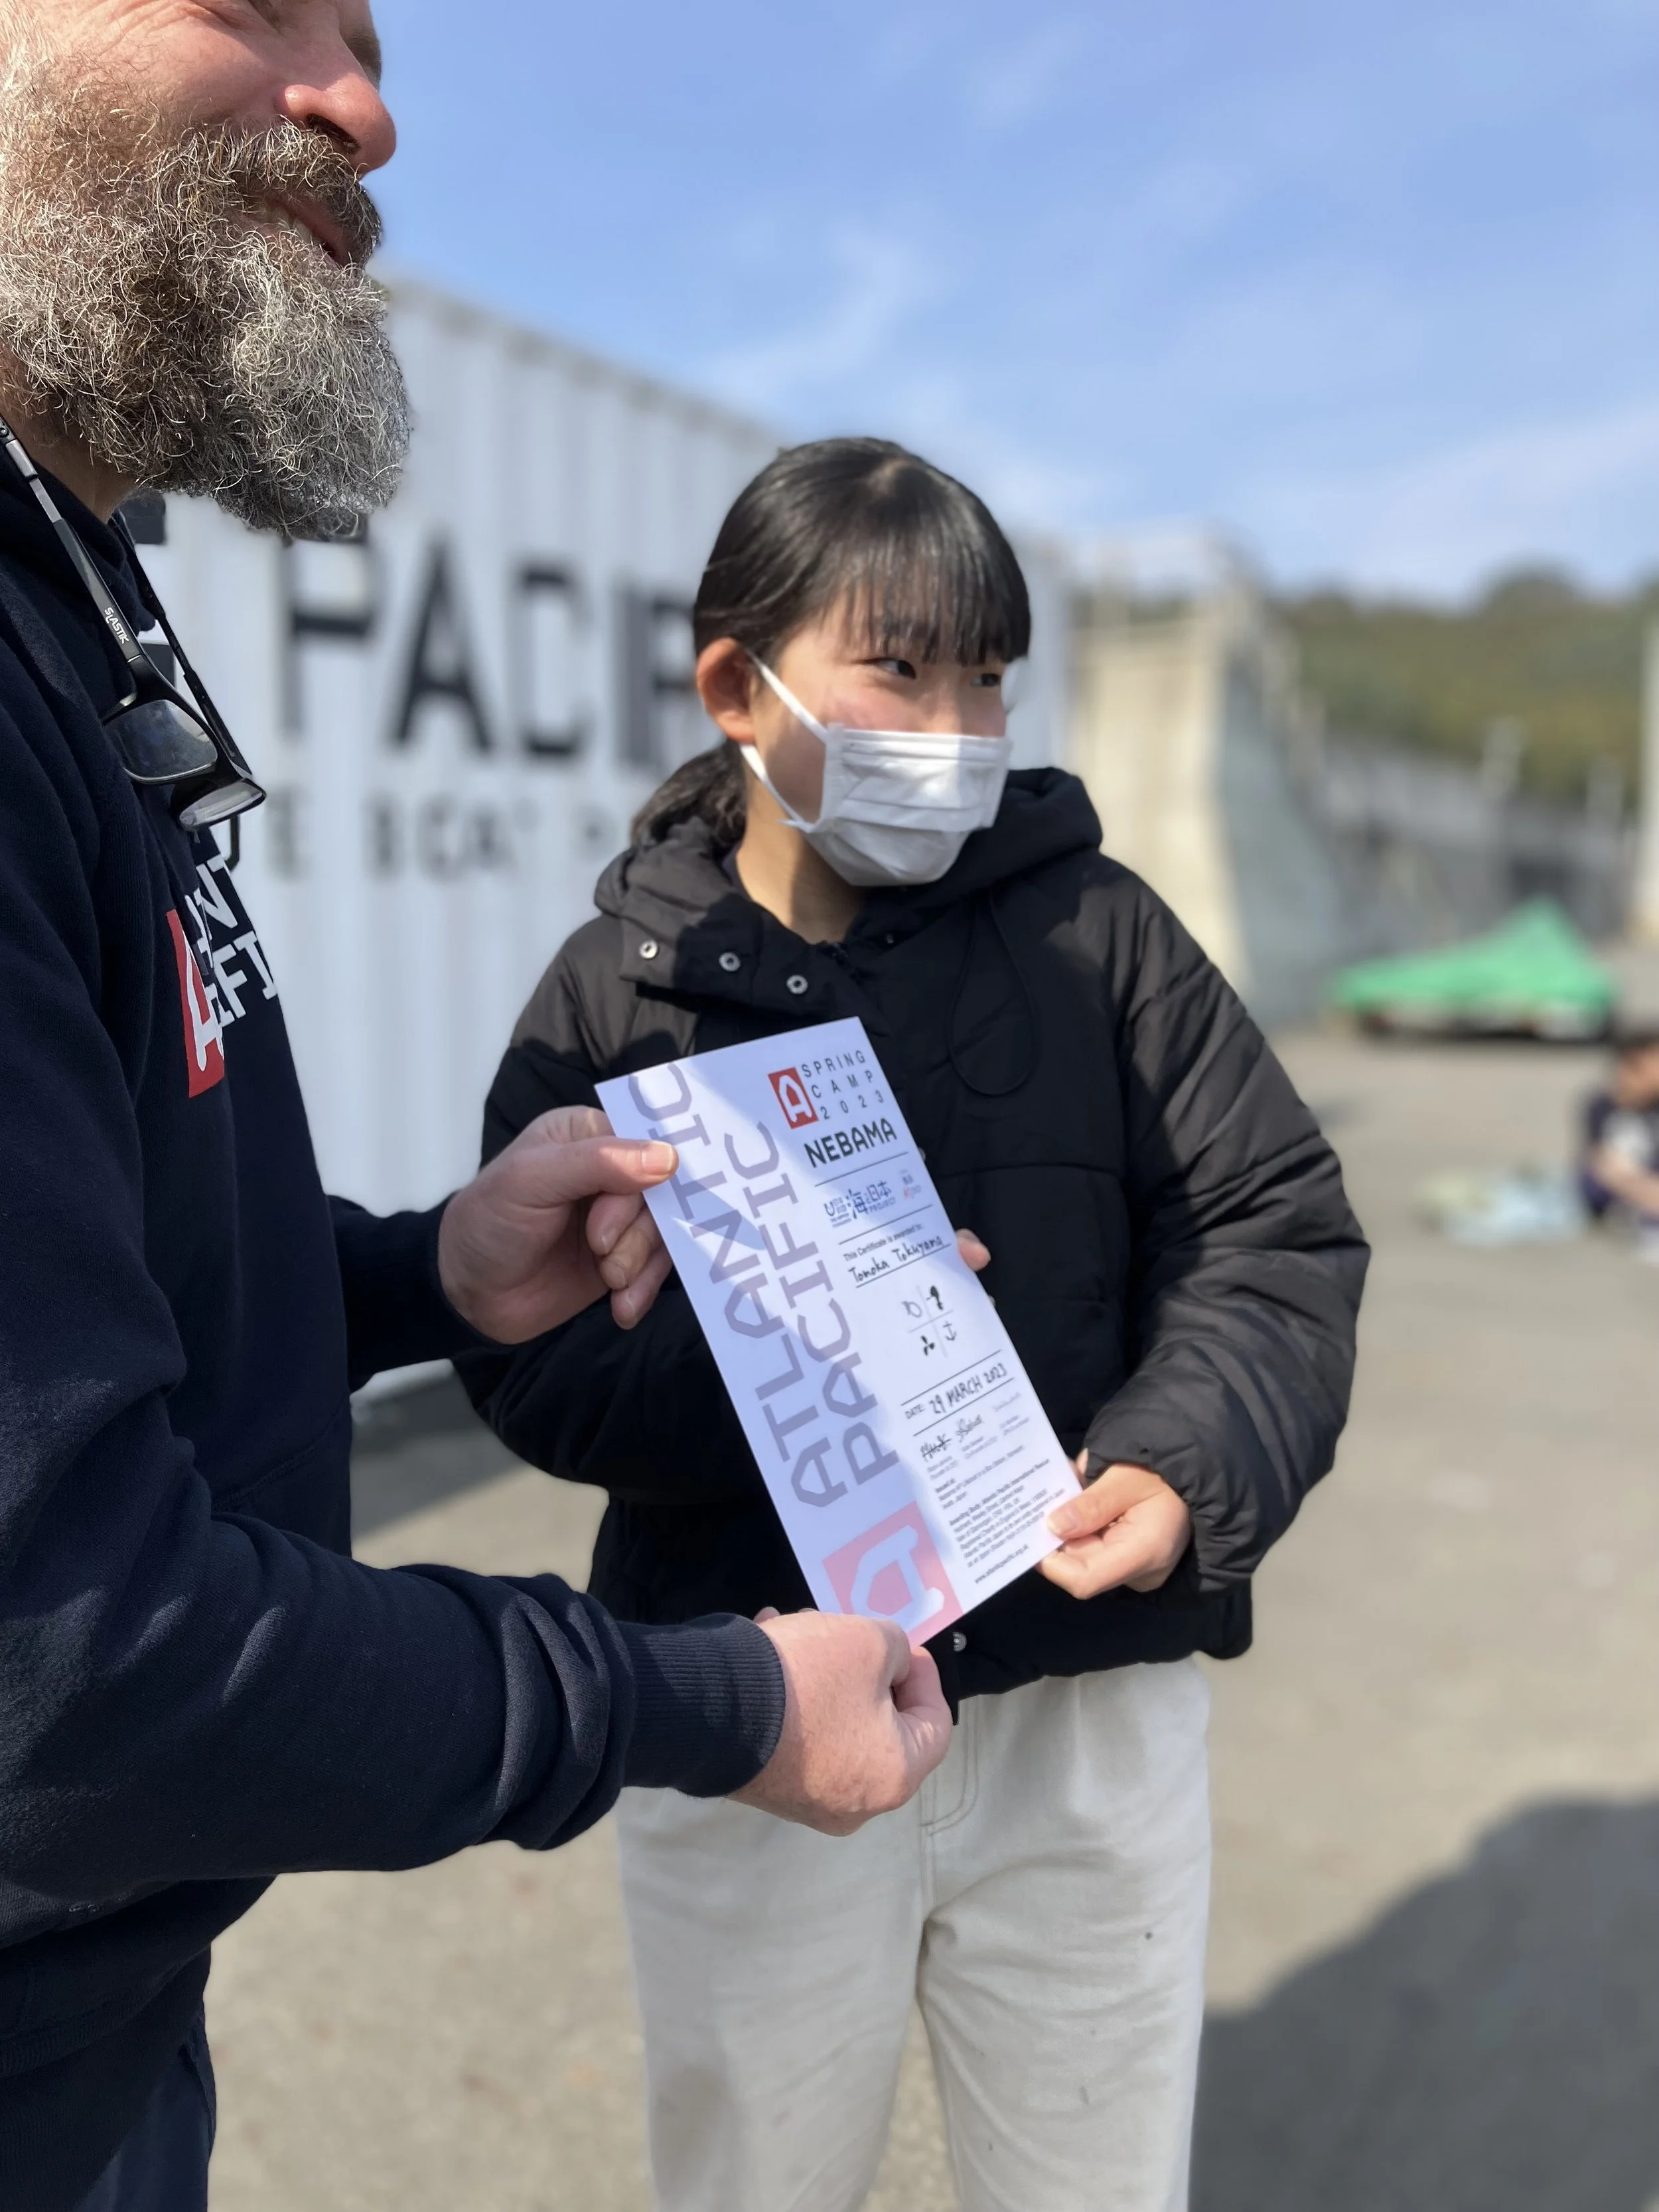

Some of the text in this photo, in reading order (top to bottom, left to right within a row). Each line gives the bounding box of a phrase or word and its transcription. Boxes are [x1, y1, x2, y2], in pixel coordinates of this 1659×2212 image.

[104, 607, 130, 644] SLASTIK
[801, 1050, 866, 1078] SPRING
[811, 1070, 873, 1098] CAMP
[820, 1090, 885, 1120] 2023
[804, 1118, 898, 1168] NEBAMA
[843, 1252, 858, 1262] This
[857, 1238, 887, 1256] Certificate
[628, 1063, 849, 1507] ATLANTIC
[724, 1121, 900, 1486] PACIFIC
[929, 1394, 947, 1414] 29
[946, 1374, 983, 1408] MARCH
[983, 1363, 1008, 1384] 2023
